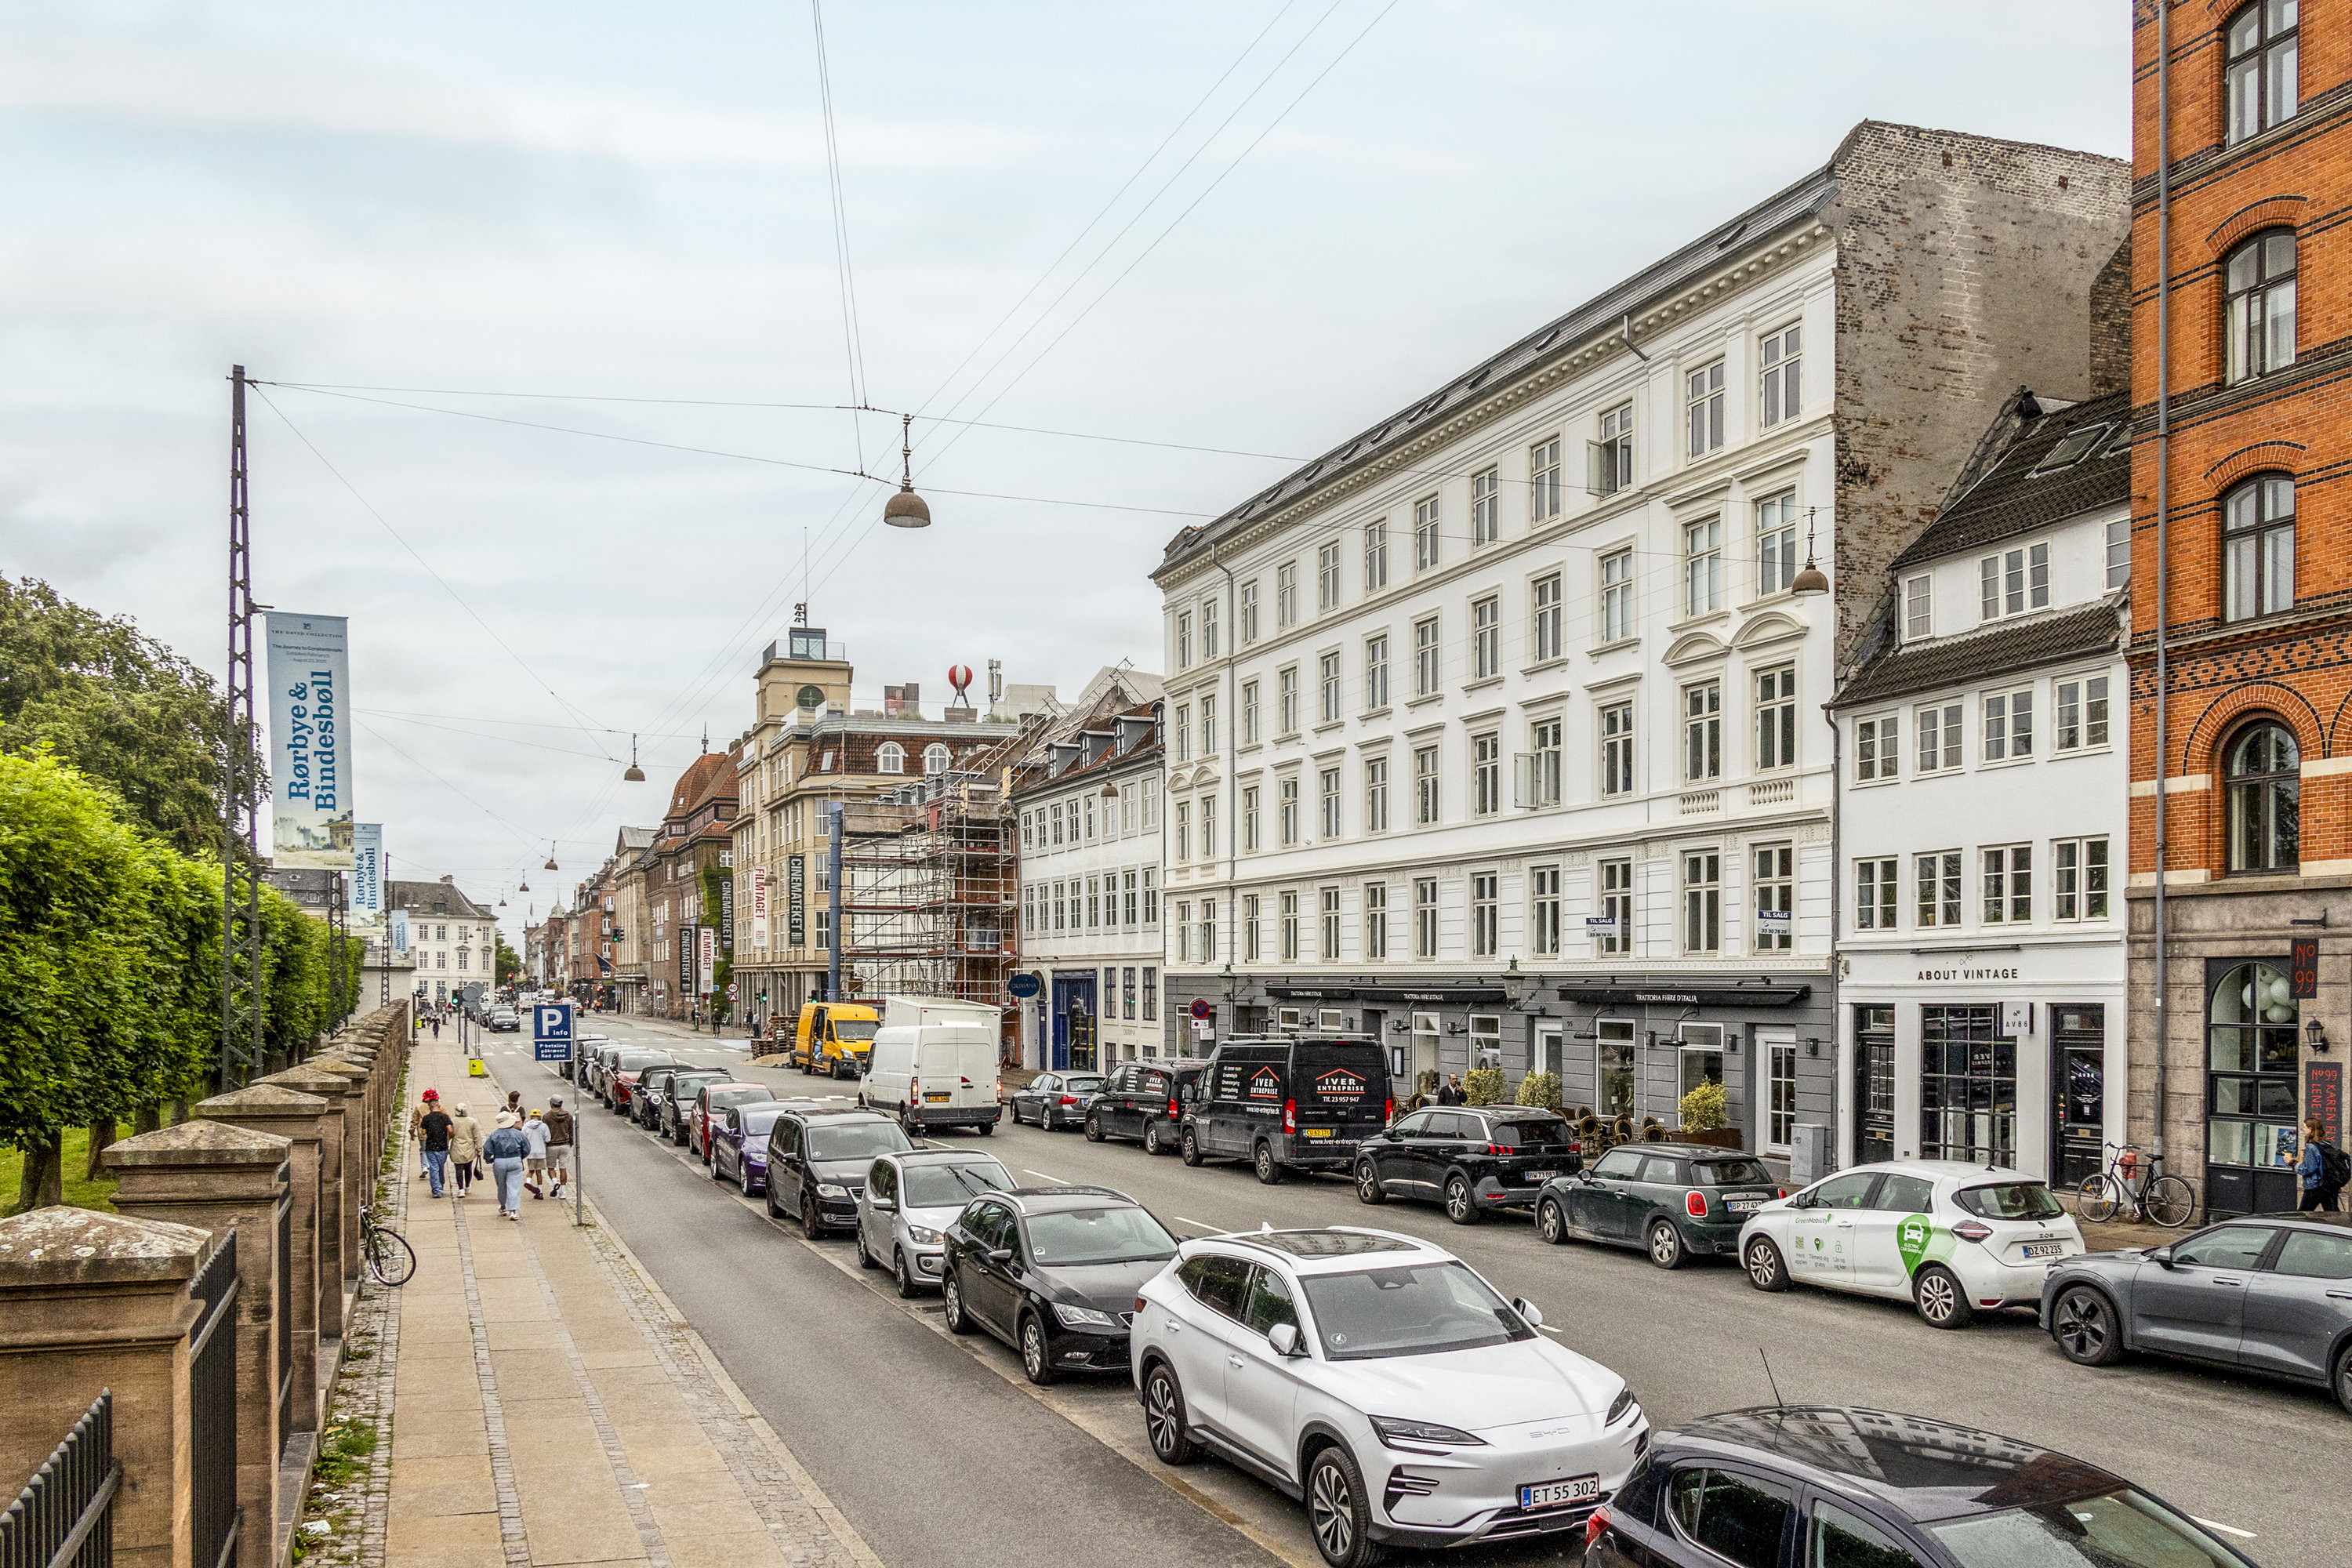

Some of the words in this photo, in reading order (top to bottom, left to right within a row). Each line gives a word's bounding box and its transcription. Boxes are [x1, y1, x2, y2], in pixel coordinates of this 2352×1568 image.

[289, 682, 307, 701] &
[287, 705, 314, 800] Rørbye
[310, 670, 336, 812] Bindesbøll
[356, 853, 365, 862] &
[354, 866, 367, 906] Rørbye
[365, 848, 377, 910] Bindesbøll
[755, 868, 765, 920] FILMTAGET
[790, 858, 802, 931] CINEMATEKET
[722, 880, 731, 940] CINEMATEKET
[681, 931, 690, 985] CINEMATEKET
[1918, 970, 1957, 980] ABOUT
[1963, 968, 2018, 979] VINTAGE
[2295, 971, 2314, 993] 99
[542, 1008, 563, 1036] P
[1255, 1078, 1274, 1087] IVER
[2311, 1083, 2321, 1108] LENE
[2325, 1084, 2336, 1121] KAREN
[2325, 1126, 2336, 1142] FLY
[2028, 1247, 2039, 1255] DZ
[2040, 1246, 2049, 1254] 92
[2049, 1245, 2062, 1254] 235
[1530, 1427, 1570, 1439] BYD
[1533, 1487, 1550, 1504] ET
[1554, 1485, 1569, 1501] 55
[1573, 1480, 1597, 1497] 302
